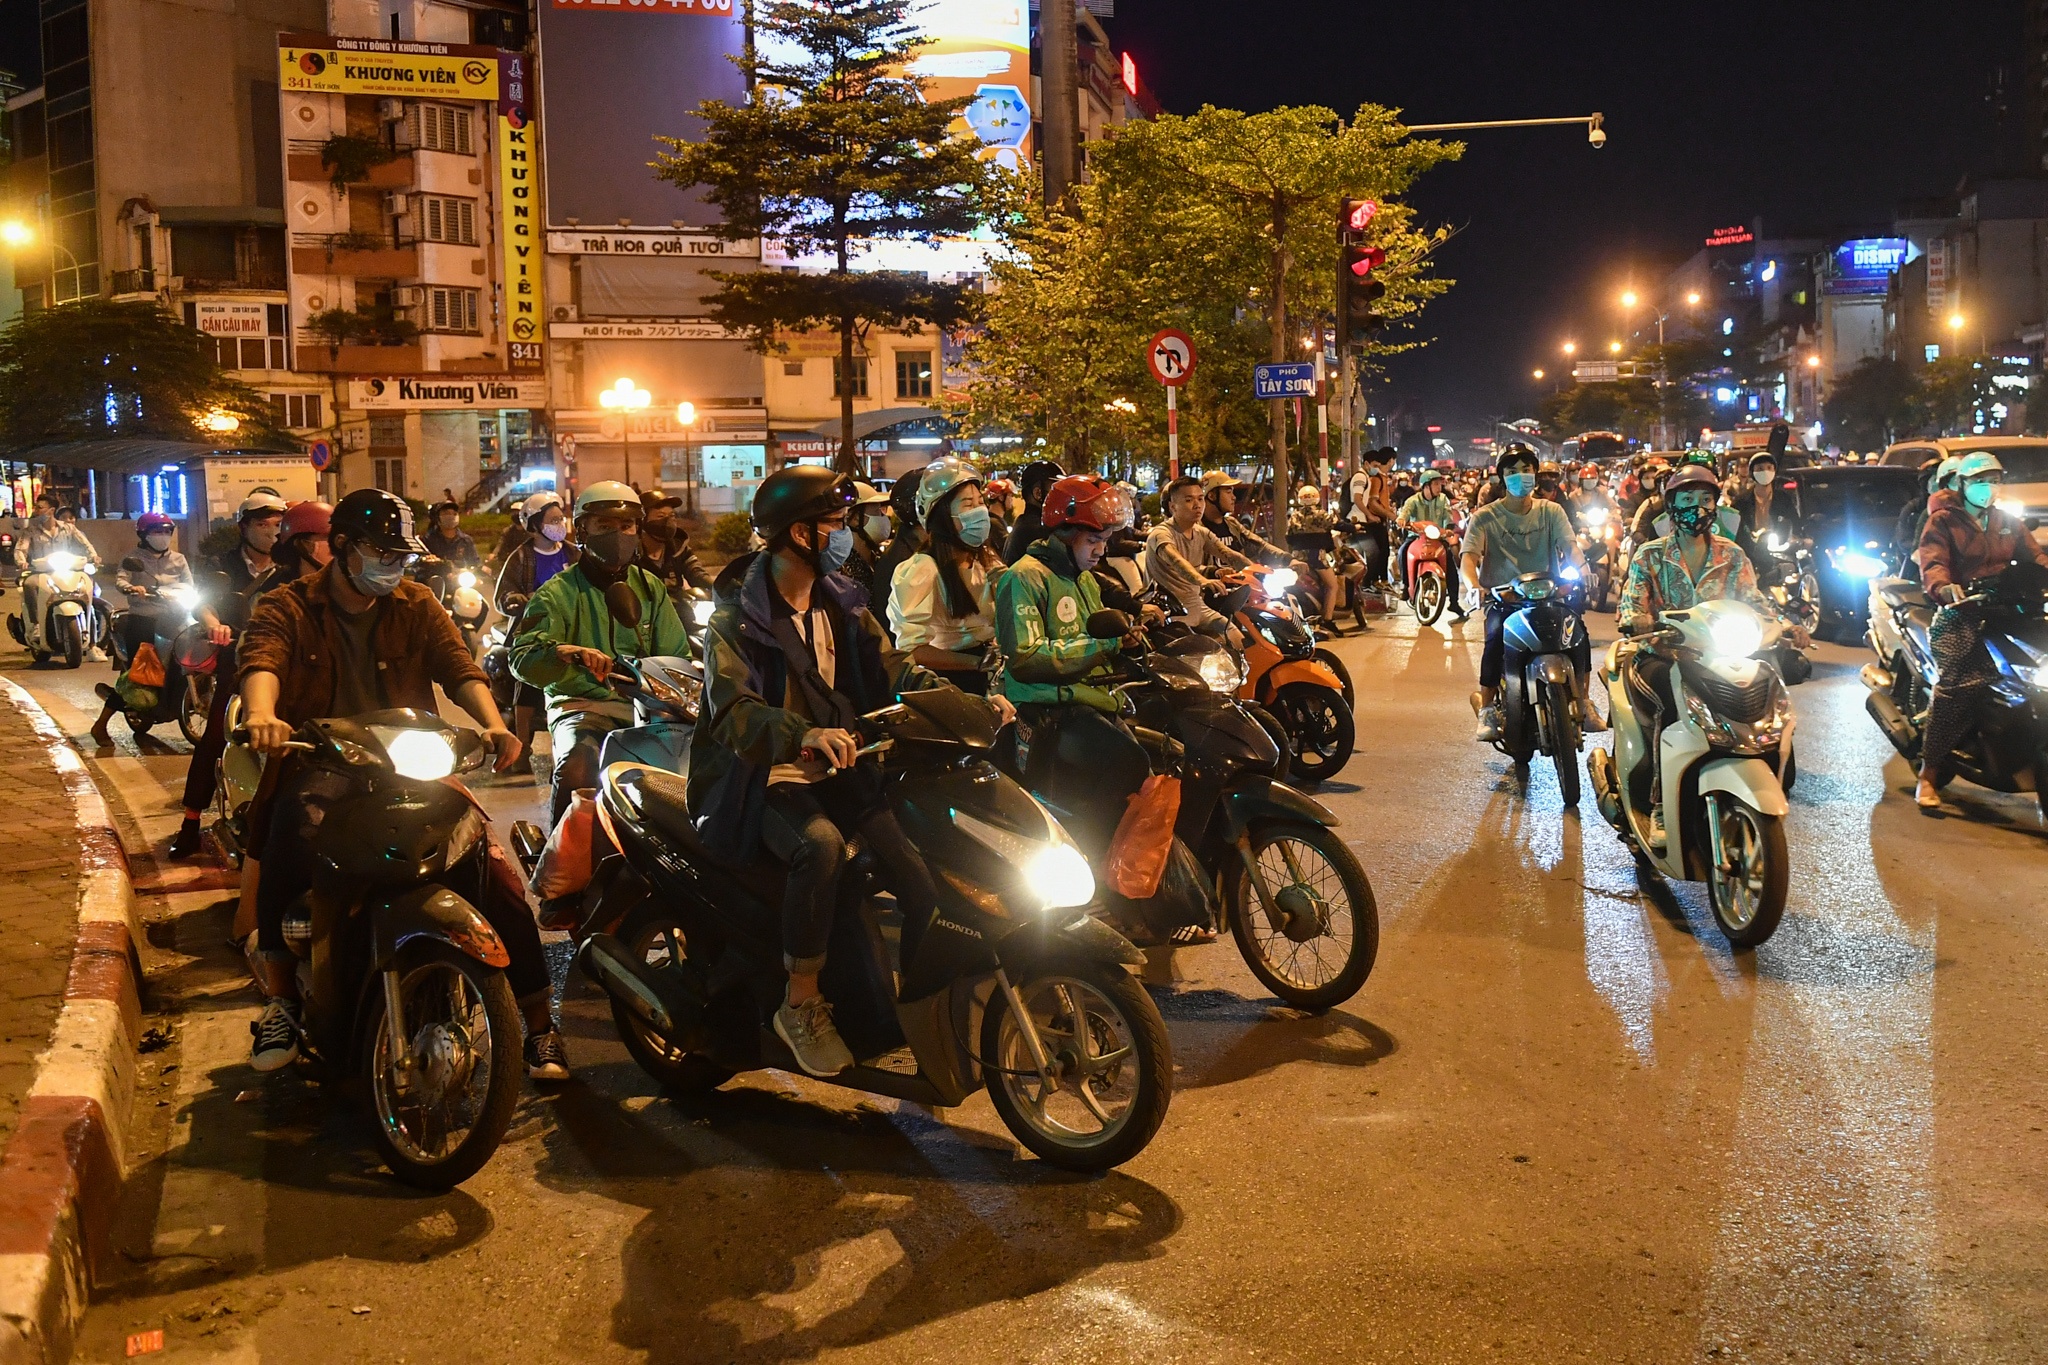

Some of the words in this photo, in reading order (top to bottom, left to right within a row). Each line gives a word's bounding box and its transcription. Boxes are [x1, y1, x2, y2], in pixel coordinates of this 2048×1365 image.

[337, 39, 358, 50] CÔNG
[359, 41, 368, 51] TY
[392, 42, 397, 52] Y
[345, 64, 414, 82] KHƯƠNG
[418, 66, 456, 84] VIÊN
[288, 77, 312, 88] 341
[510, 130, 529, 237] KHƯƠNG
[582, 236, 608, 252] TRÀ
[615, 239, 645, 252] HOA
[652, 237, 682, 254] QUẢ
[689, 241, 724, 254] TƯƠI
[1854, 249, 1900, 265] DISMY
[515, 246, 532, 314] VIÊN
[583, 326, 599, 336] Full
[601, 326, 613, 336] Of
[617, 326, 643, 336] Fresh
[511, 343, 541, 360] 341
[1279, 366, 1298, 376] PHỐ
[399, 378, 474, 404] Khương
[477, 382, 518, 400] Viên
[1260, 378, 1282, 392] TÂY
[1285, 378, 1312, 392] SƠN
[1016, 604, 1039, 616] Gra
[1059, 622, 1080, 636] Grab
[936, 918, 982, 939] HONDA
